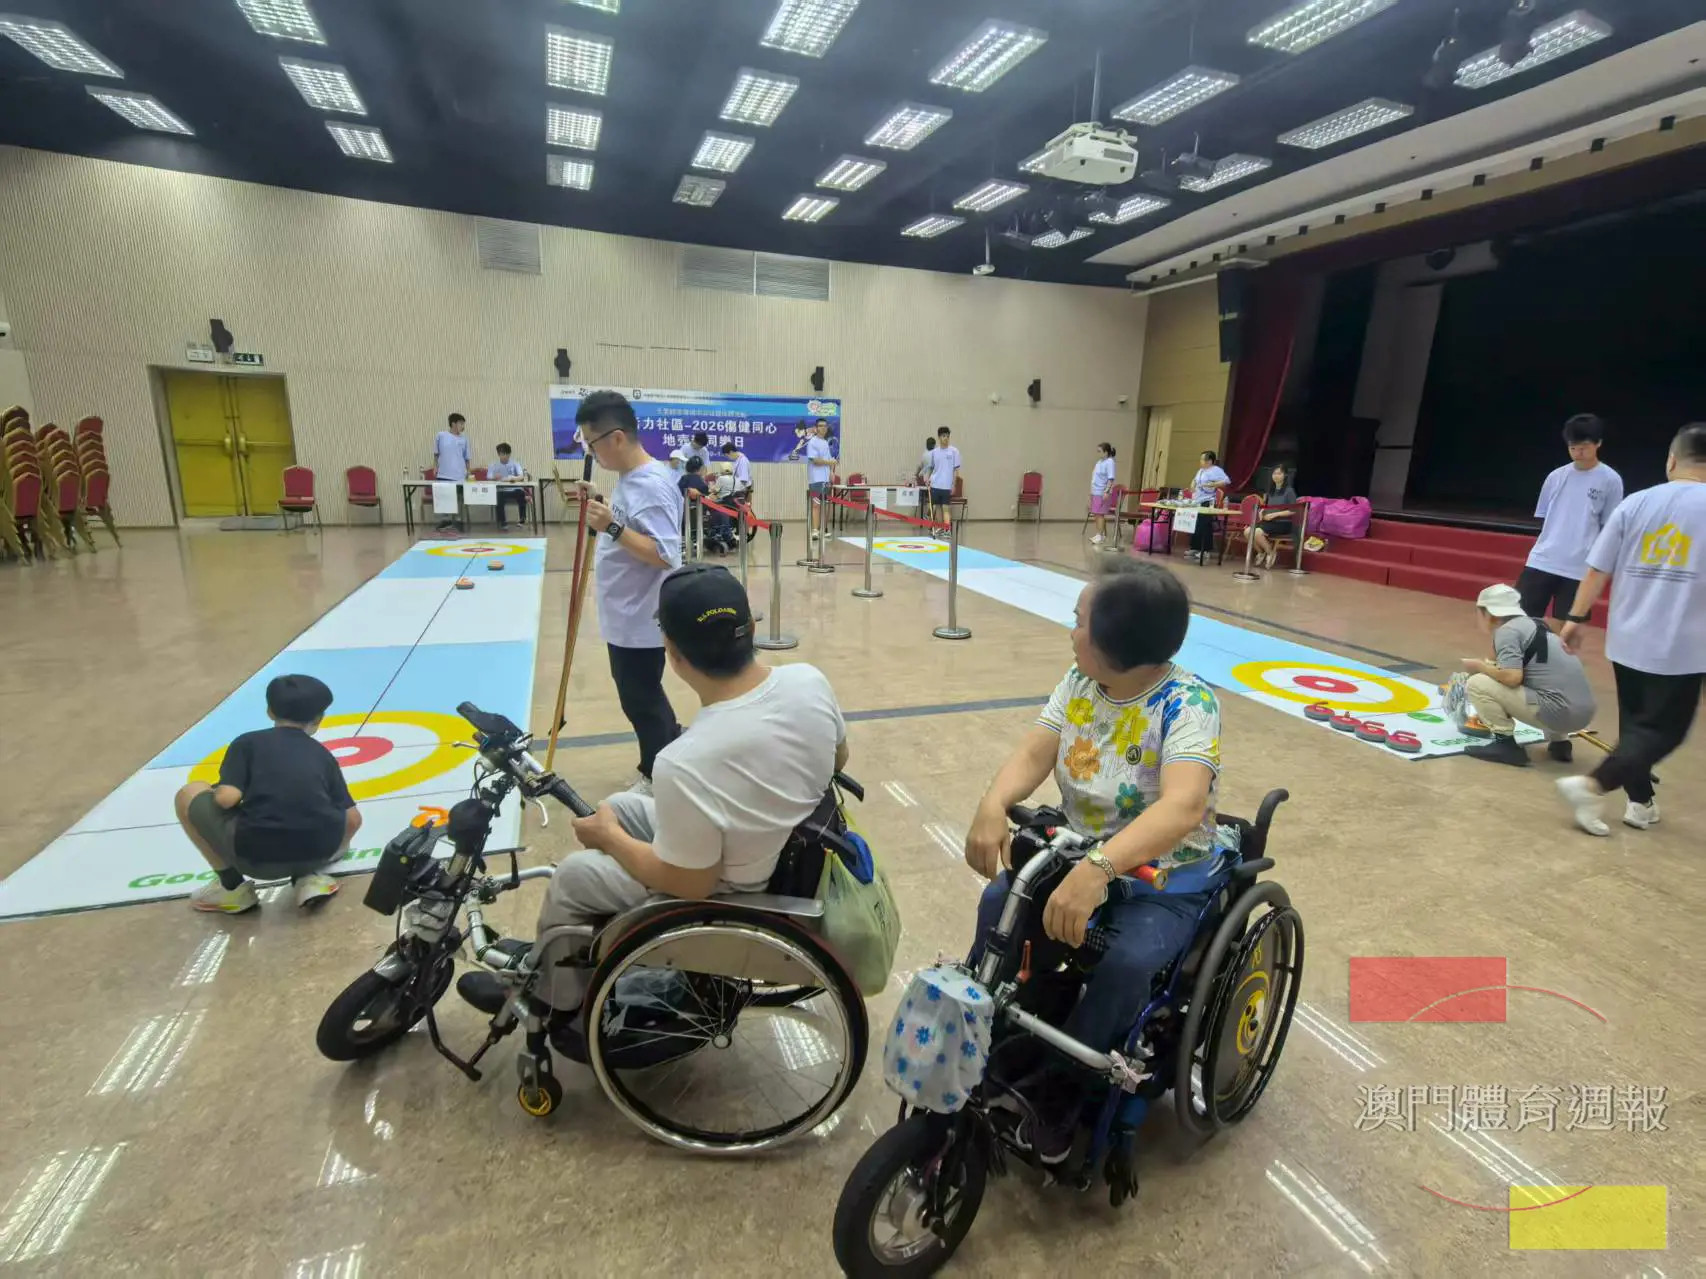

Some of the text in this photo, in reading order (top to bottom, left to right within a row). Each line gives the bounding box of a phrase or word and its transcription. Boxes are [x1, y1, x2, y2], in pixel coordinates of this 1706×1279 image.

[663, 433, 744, 448] 地壺同樂日
[128, 870, 218, 888] Goo
